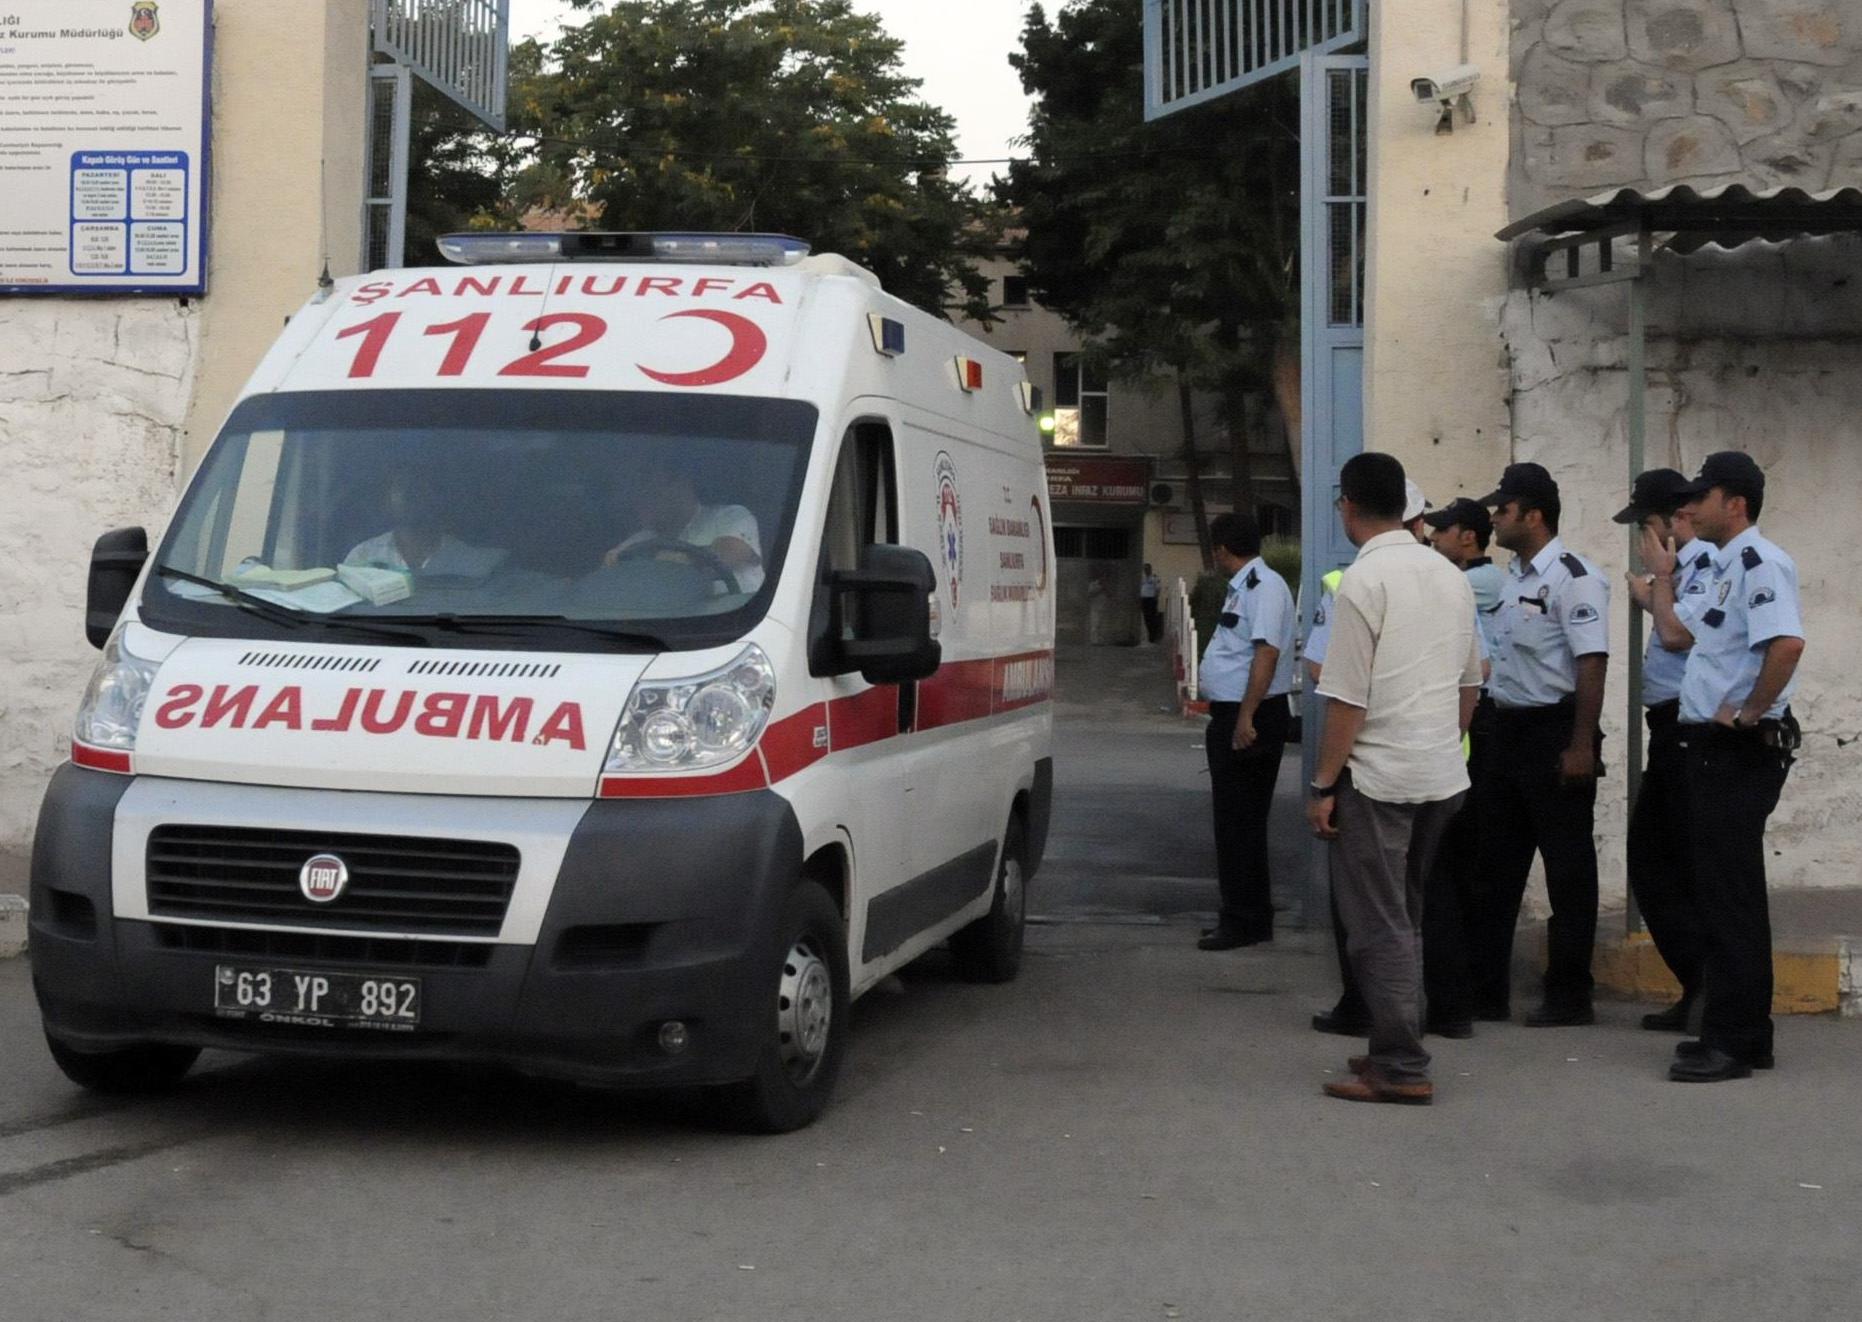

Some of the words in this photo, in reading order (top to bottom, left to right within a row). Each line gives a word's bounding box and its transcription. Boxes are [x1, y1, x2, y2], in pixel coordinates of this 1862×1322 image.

[9, 30, 56, 39] Kurumu
[60, 28, 124, 40] Müdürlüğü
[351, 276, 784, 307] ŞANLIURFA
[335, 311, 608, 378] 112
[1049, 484, 1069, 496] EZA
[310, 867, 338, 890] FIAT
[236, 972, 272, 1006] 63
[294, 976, 329, 1011] YP
[361, 980, 416, 1018] 892
